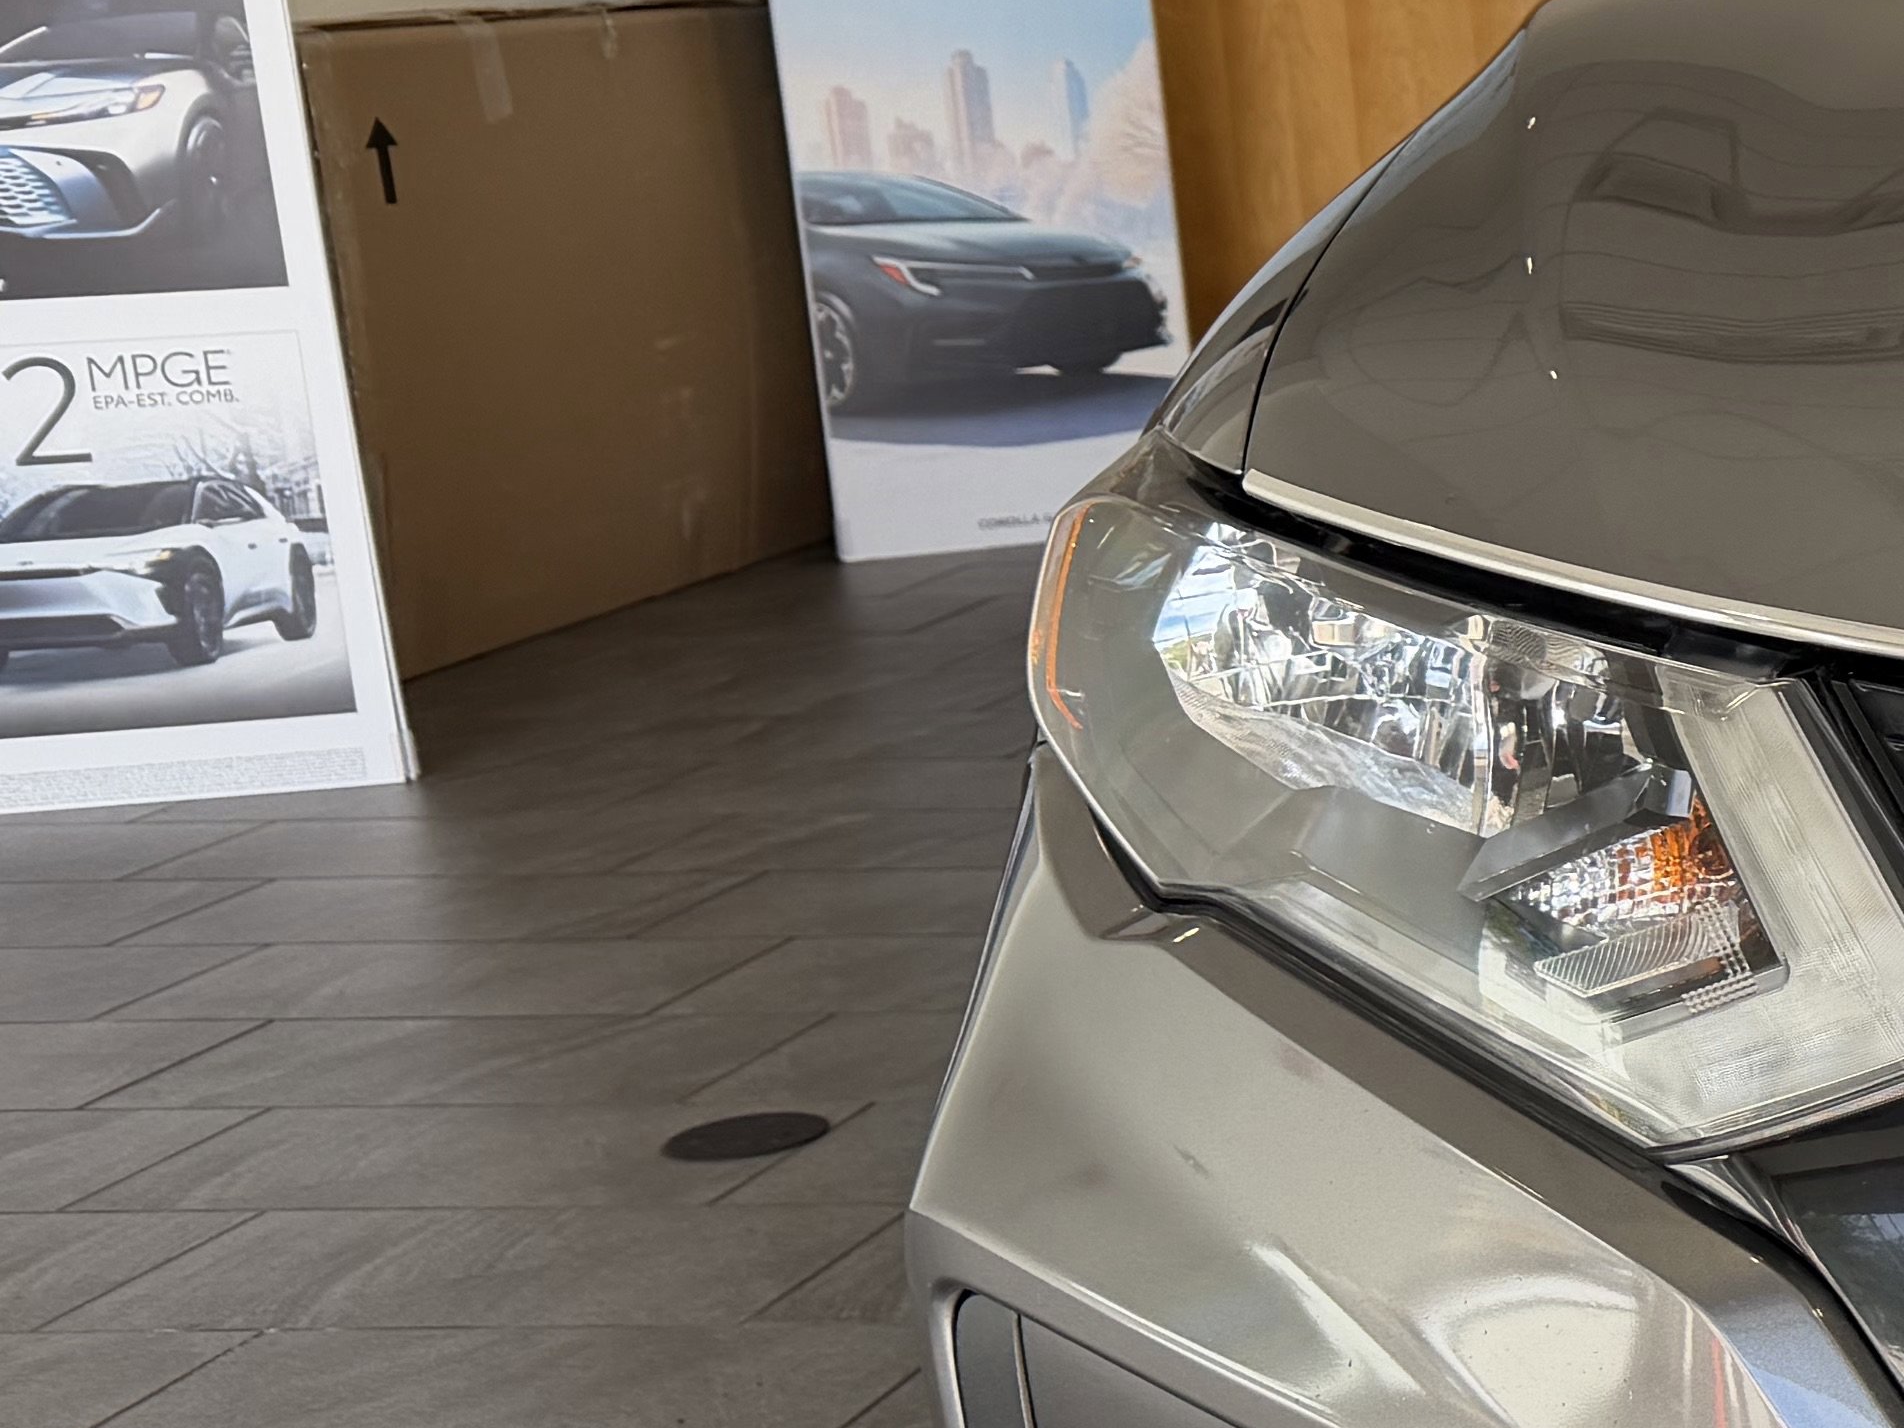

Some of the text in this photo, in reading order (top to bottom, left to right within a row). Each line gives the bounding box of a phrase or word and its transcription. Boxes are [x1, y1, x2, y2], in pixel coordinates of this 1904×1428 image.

[86, 349, 233, 392] MPGE
[92, 387, 241, 410] EPA-EST. COMB.
